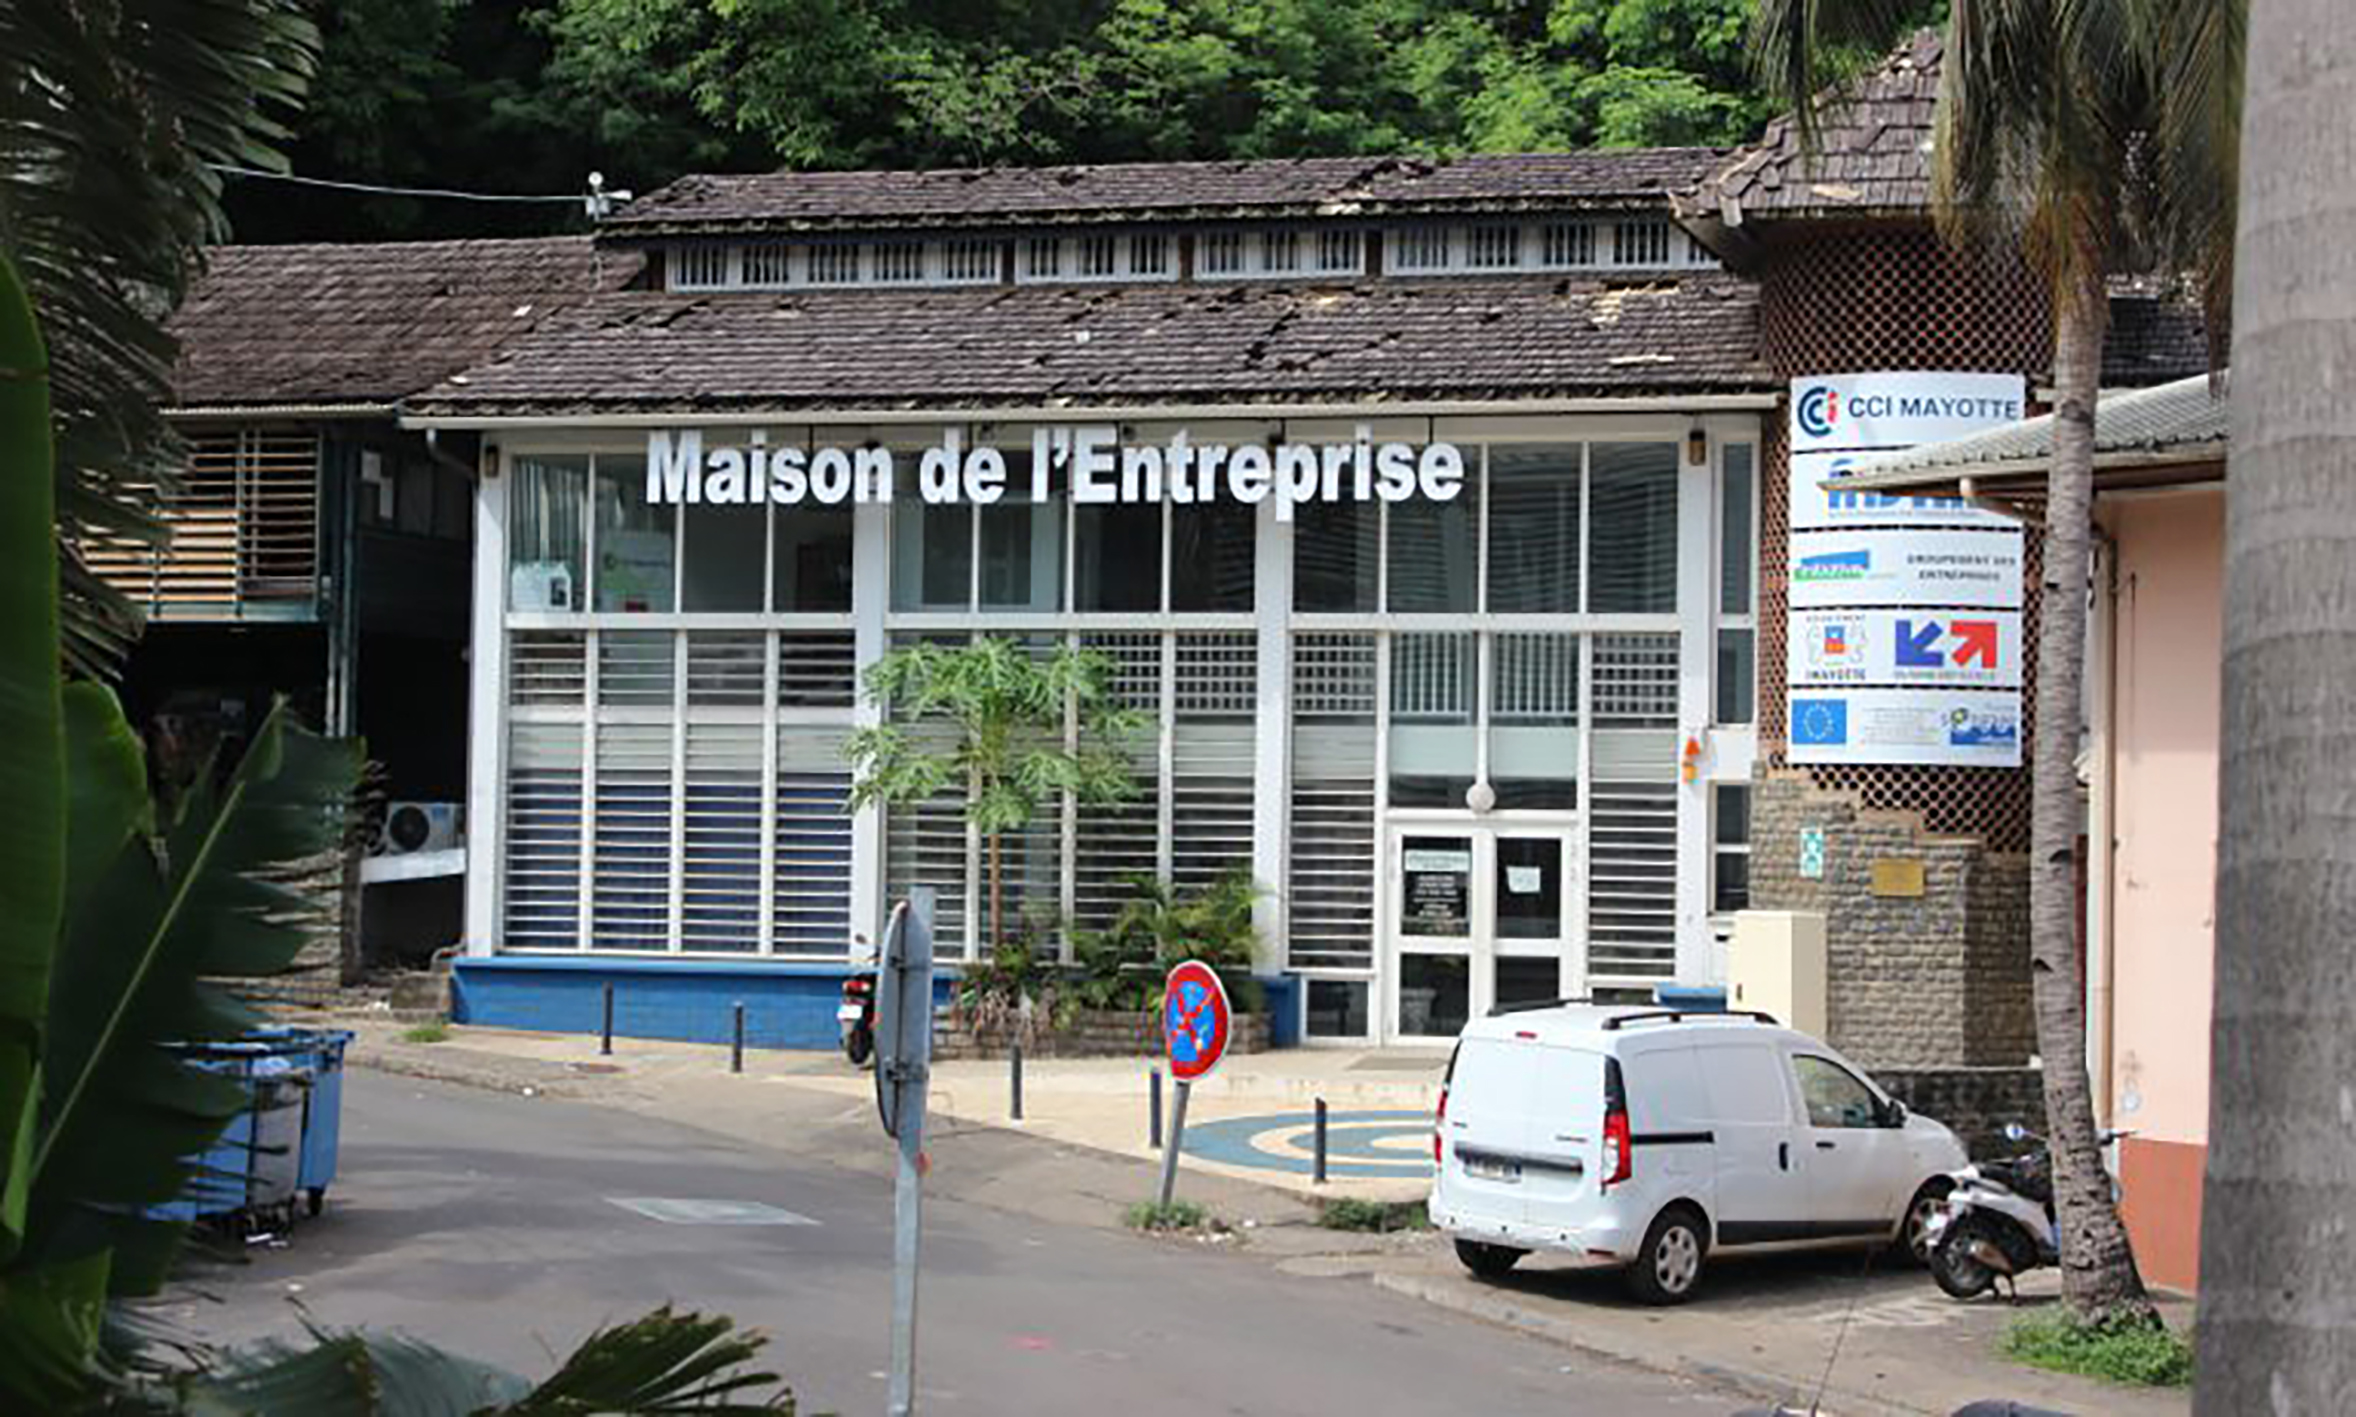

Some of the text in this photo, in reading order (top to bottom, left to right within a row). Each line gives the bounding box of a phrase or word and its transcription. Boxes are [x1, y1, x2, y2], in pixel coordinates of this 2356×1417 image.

[1848, 397, 2019, 420] CCI MAYOTTE
[646, 424, 1465, 522] Maison de l'Entreprise
